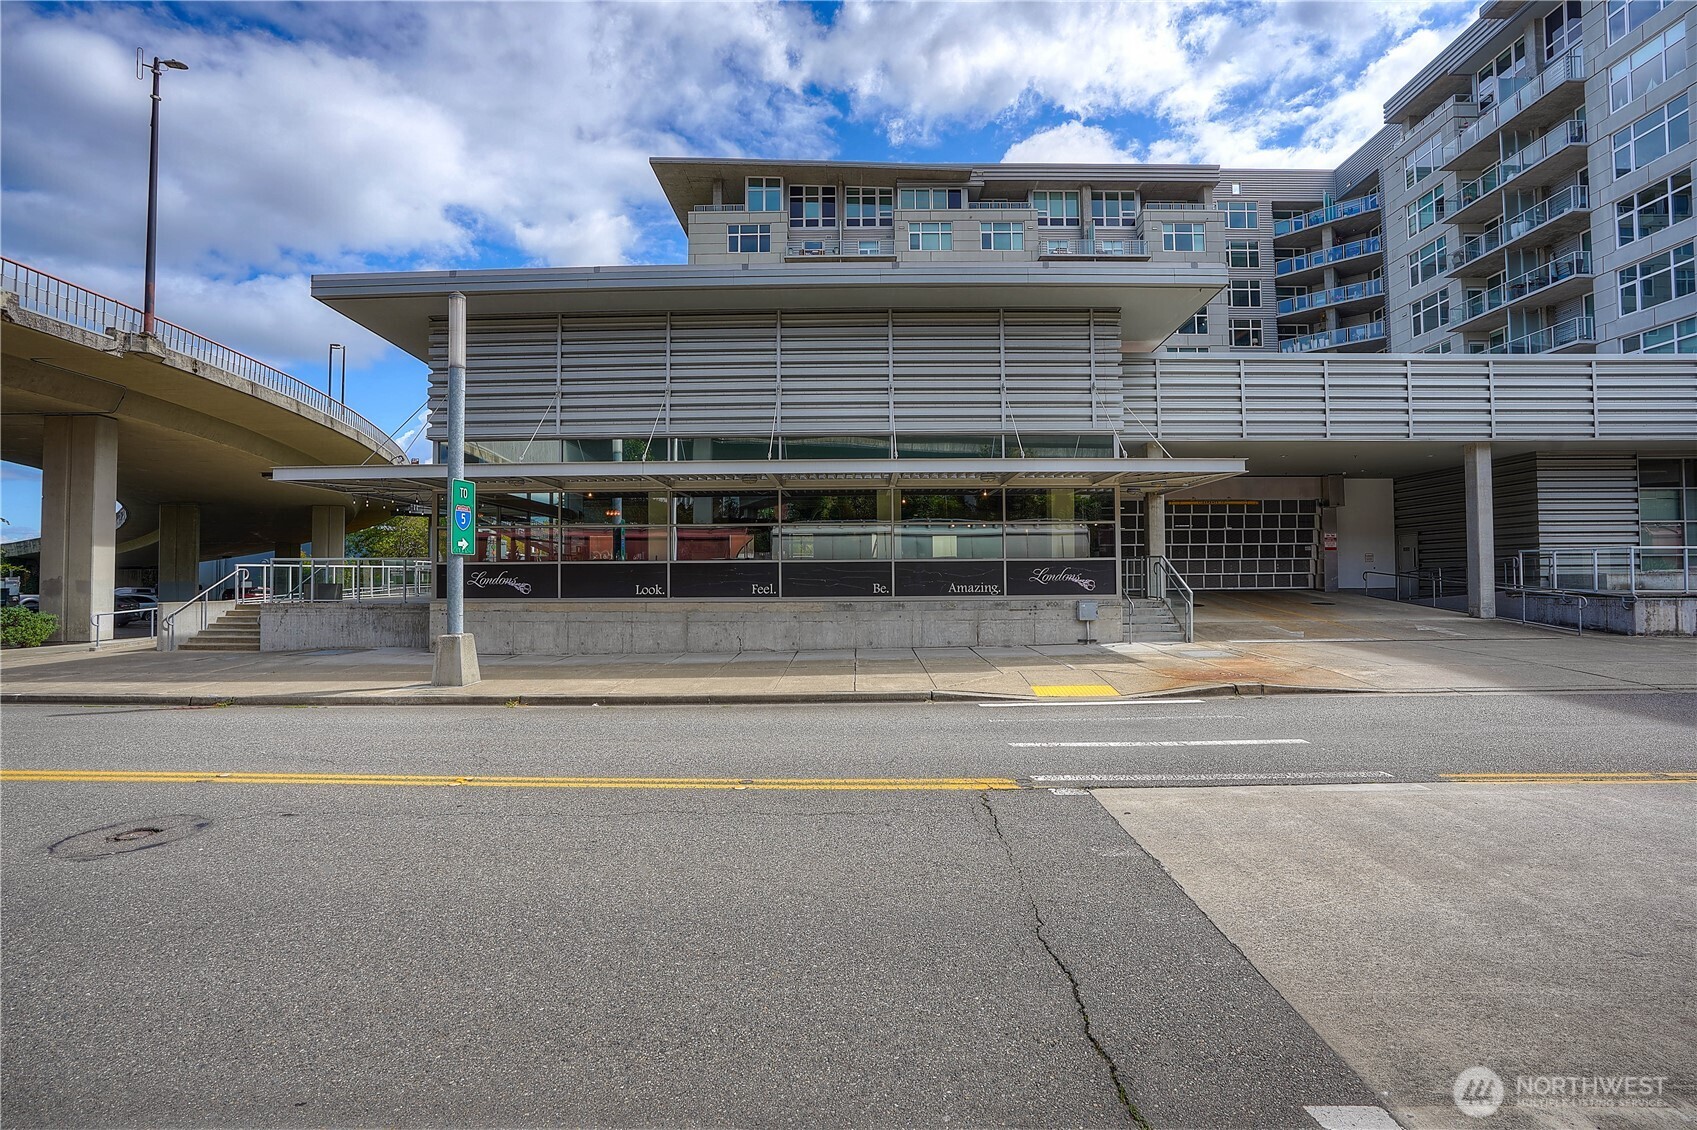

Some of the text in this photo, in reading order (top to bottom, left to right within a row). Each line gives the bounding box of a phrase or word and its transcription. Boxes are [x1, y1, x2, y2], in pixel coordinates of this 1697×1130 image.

[459, 487, 468, 499] TO
[461, 512, 466, 524] 5
[635, 584, 665, 595] Look.
[752, 584, 777, 594] Feel.
[872, 583, 889, 594] Be.
[948, 582, 1001, 595] Amazing.
